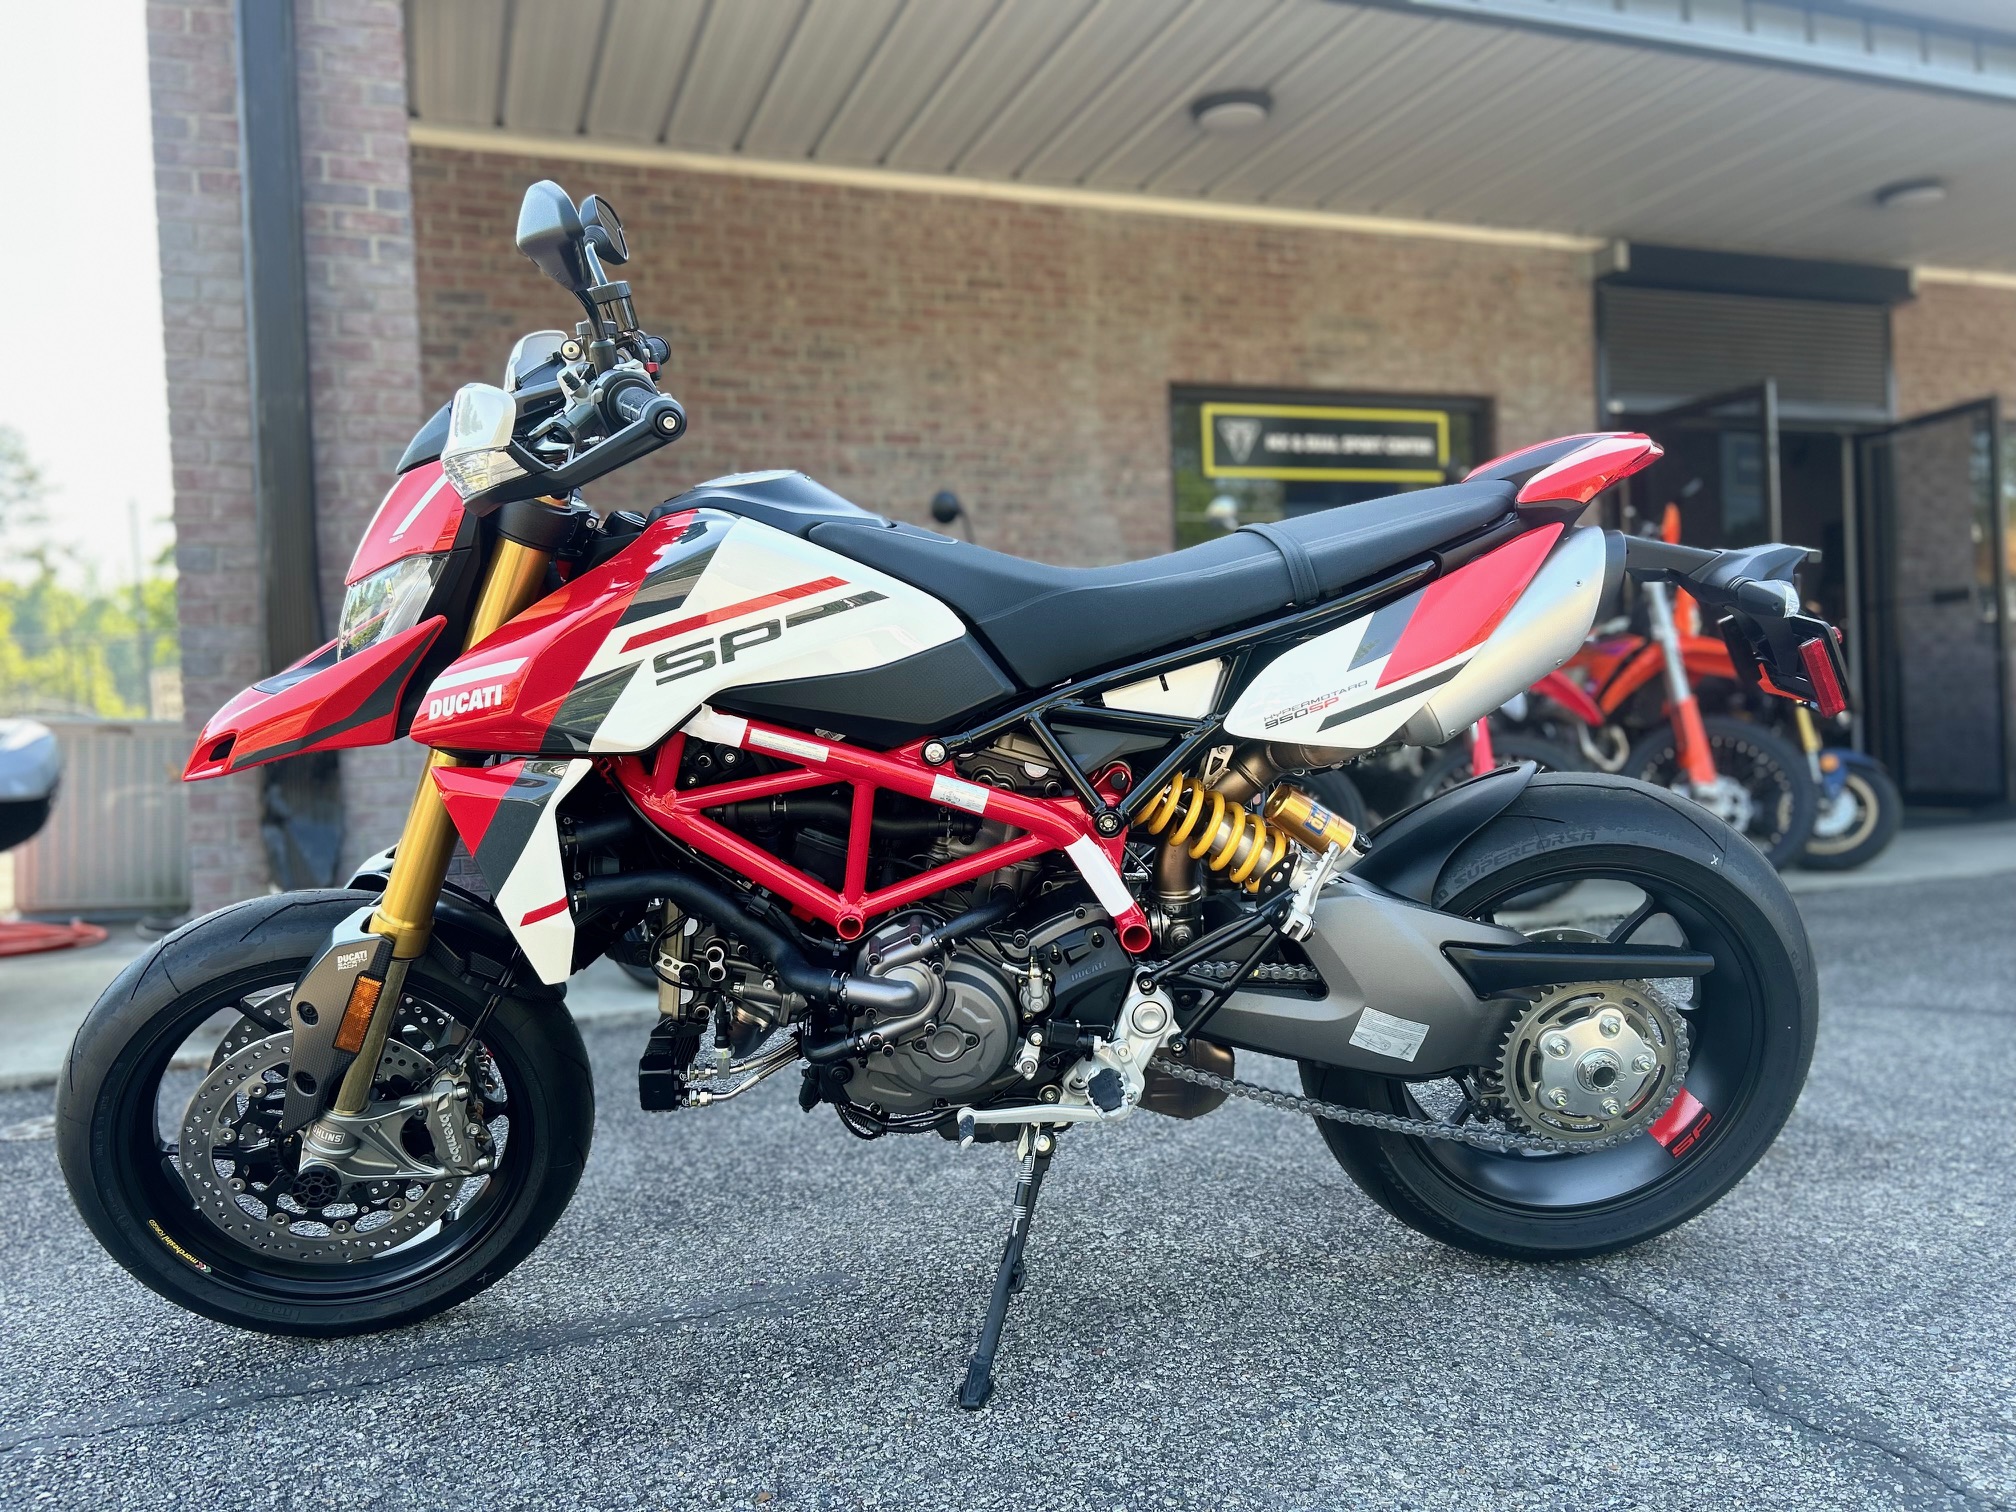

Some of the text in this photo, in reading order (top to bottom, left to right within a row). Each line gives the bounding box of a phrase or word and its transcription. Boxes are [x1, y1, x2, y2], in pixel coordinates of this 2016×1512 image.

[652, 618, 782, 687] SP
[428, 683, 503, 721] DUCATI
[1263, 680, 1368, 722] HYPERMOTARD
[1453, 830, 1597, 889] SUPERCORSA
[337, 950, 368, 963] DUCATI
[1071, 961, 1107, 981] DUCATI
[438, 1112, 463, 1164] brembo
[162, 1235, 199, 1264] marchesini
